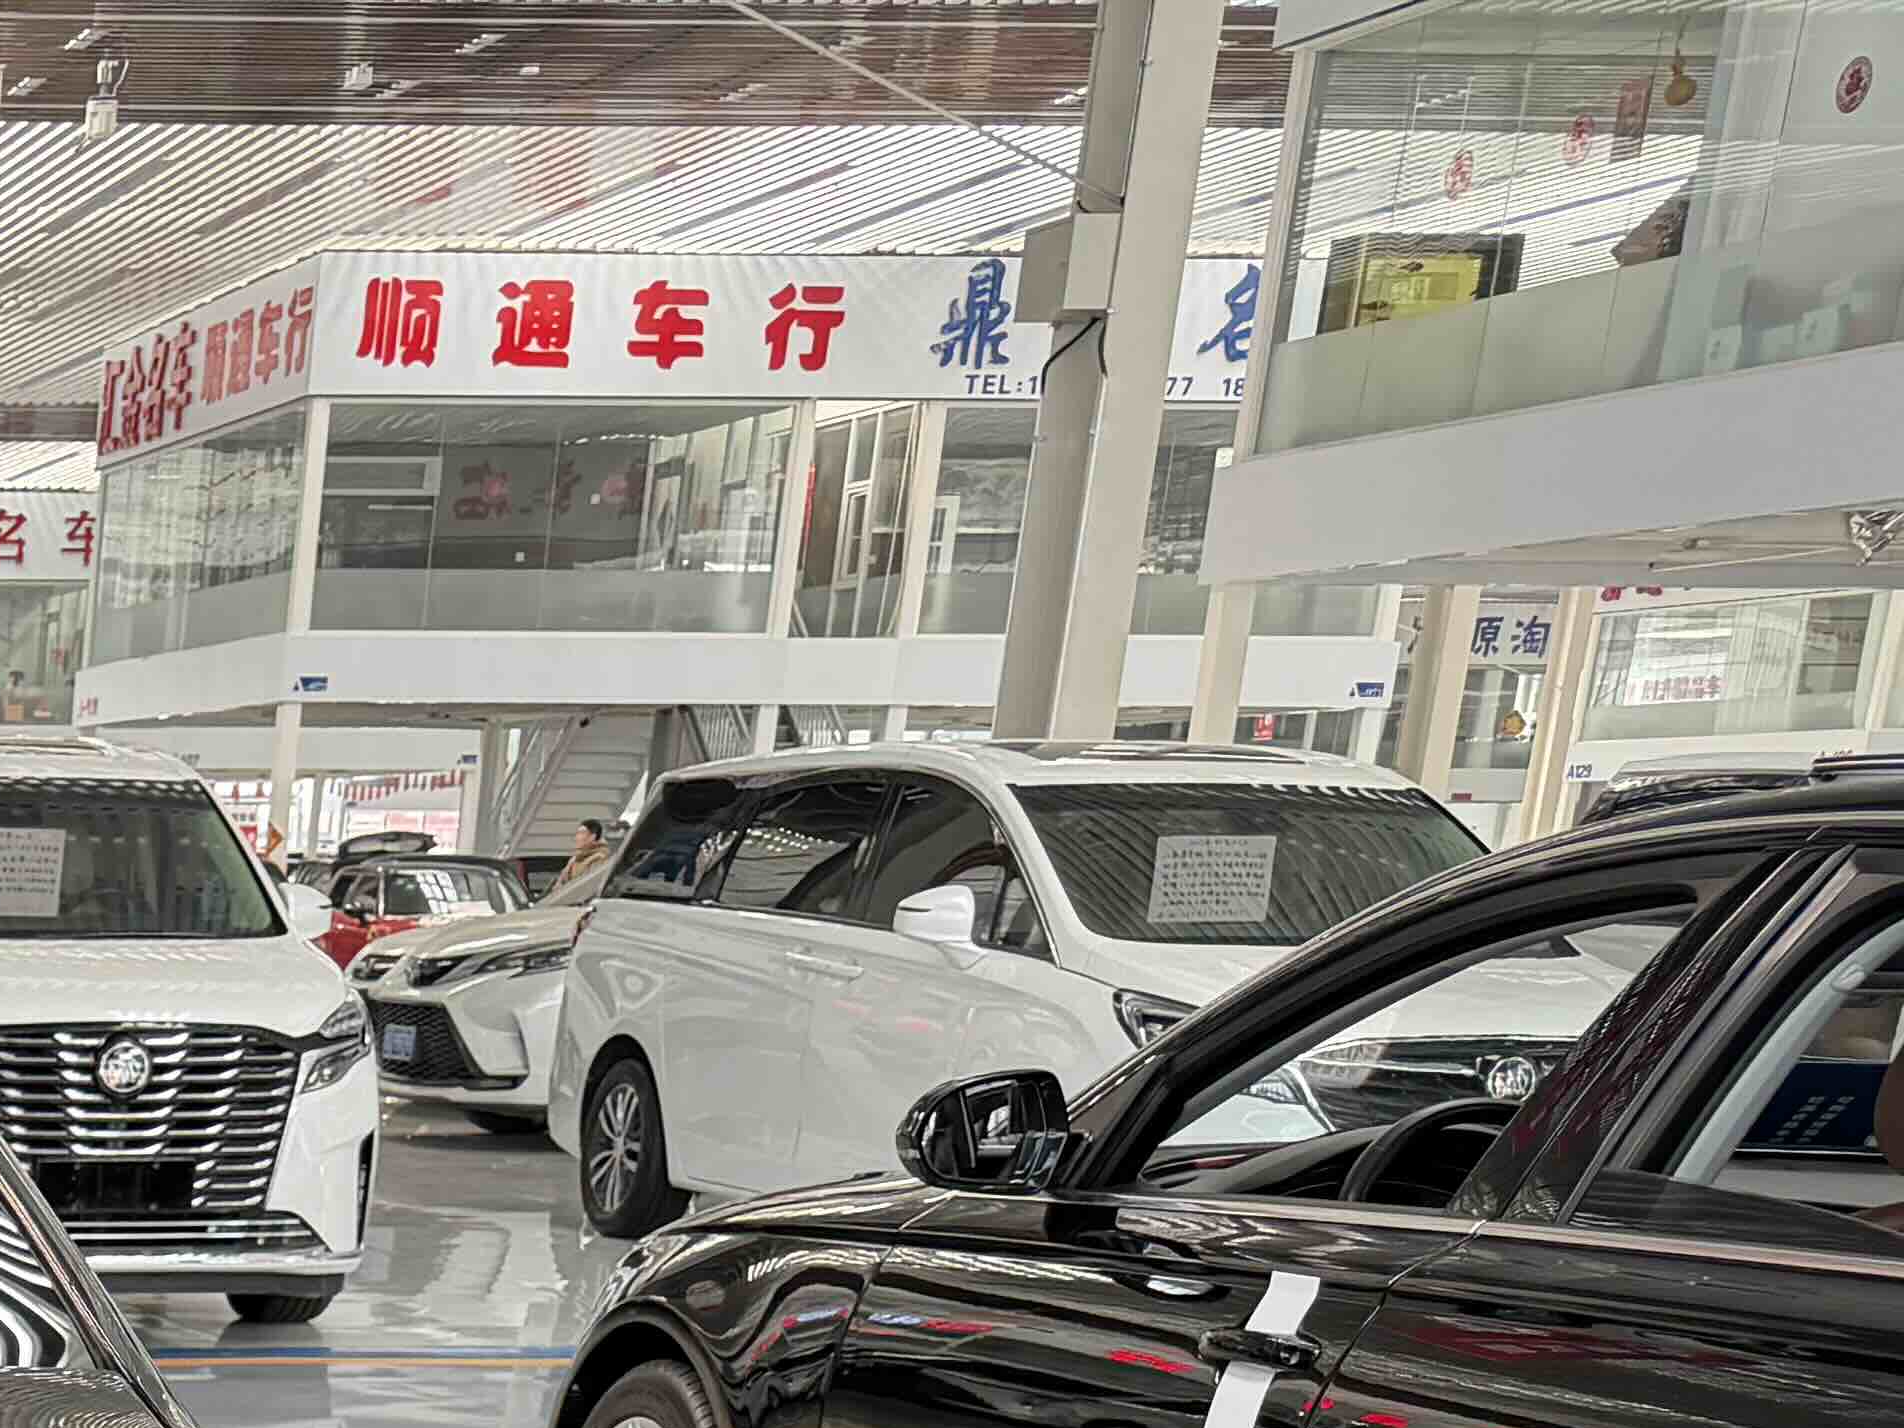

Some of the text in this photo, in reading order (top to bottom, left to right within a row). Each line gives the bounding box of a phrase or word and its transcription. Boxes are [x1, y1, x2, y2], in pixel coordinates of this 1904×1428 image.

[200, 285, 314, 405] 顺通车行
[355, 275, 847, 373] 顺通车行
